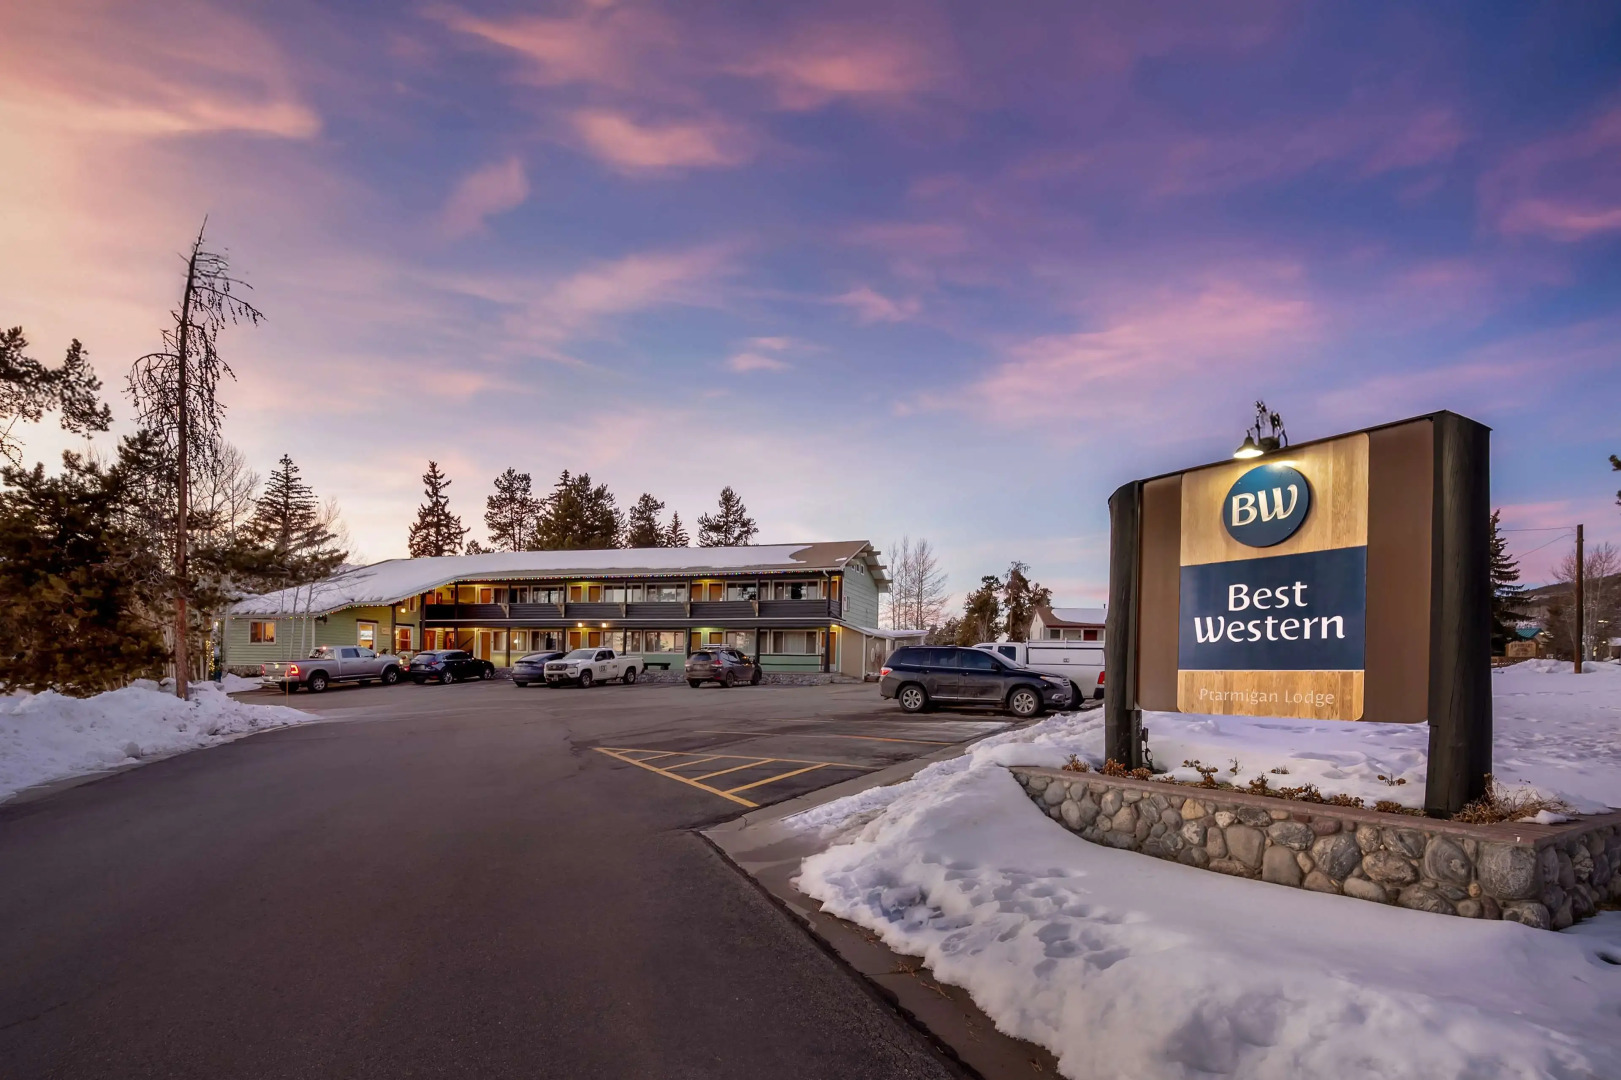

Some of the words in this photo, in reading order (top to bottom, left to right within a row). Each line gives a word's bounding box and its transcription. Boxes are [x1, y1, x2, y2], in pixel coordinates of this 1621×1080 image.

[1232, 484, 1298, 527] BW
[1228, 581, 1308, 611] Best
[1194, 615, 1345, 643] Western
[1199, 688, 1278, 704] Ptarmigan
[1285, 690, 1335, 707] Lodge
